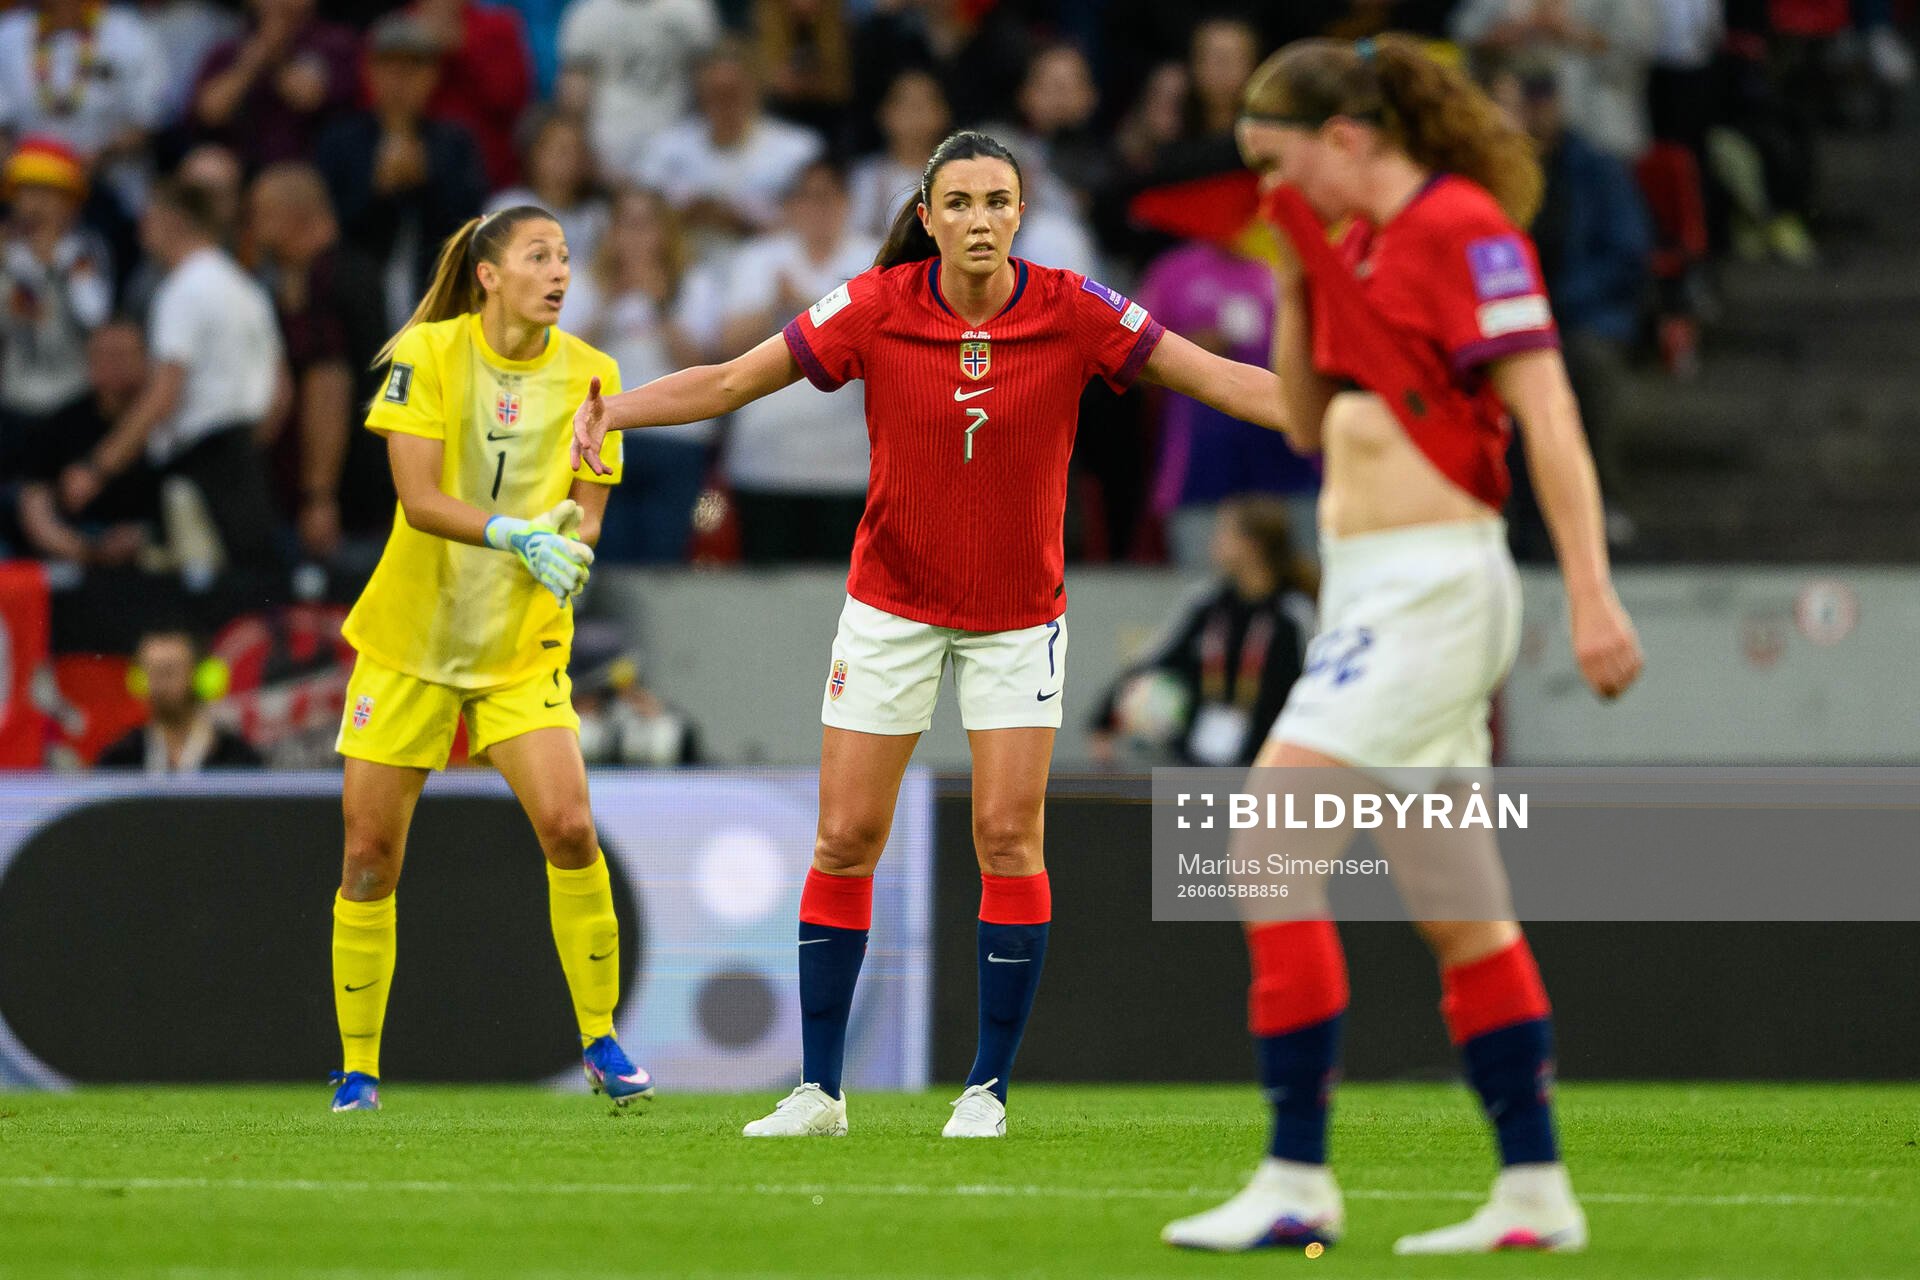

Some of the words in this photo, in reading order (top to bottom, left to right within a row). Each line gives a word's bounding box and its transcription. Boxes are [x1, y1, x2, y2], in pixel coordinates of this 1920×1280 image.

[965, 408, 989, 464] 7
[491, 451, 506, 501] 1
[1046, 620, 1060, 679] 7
